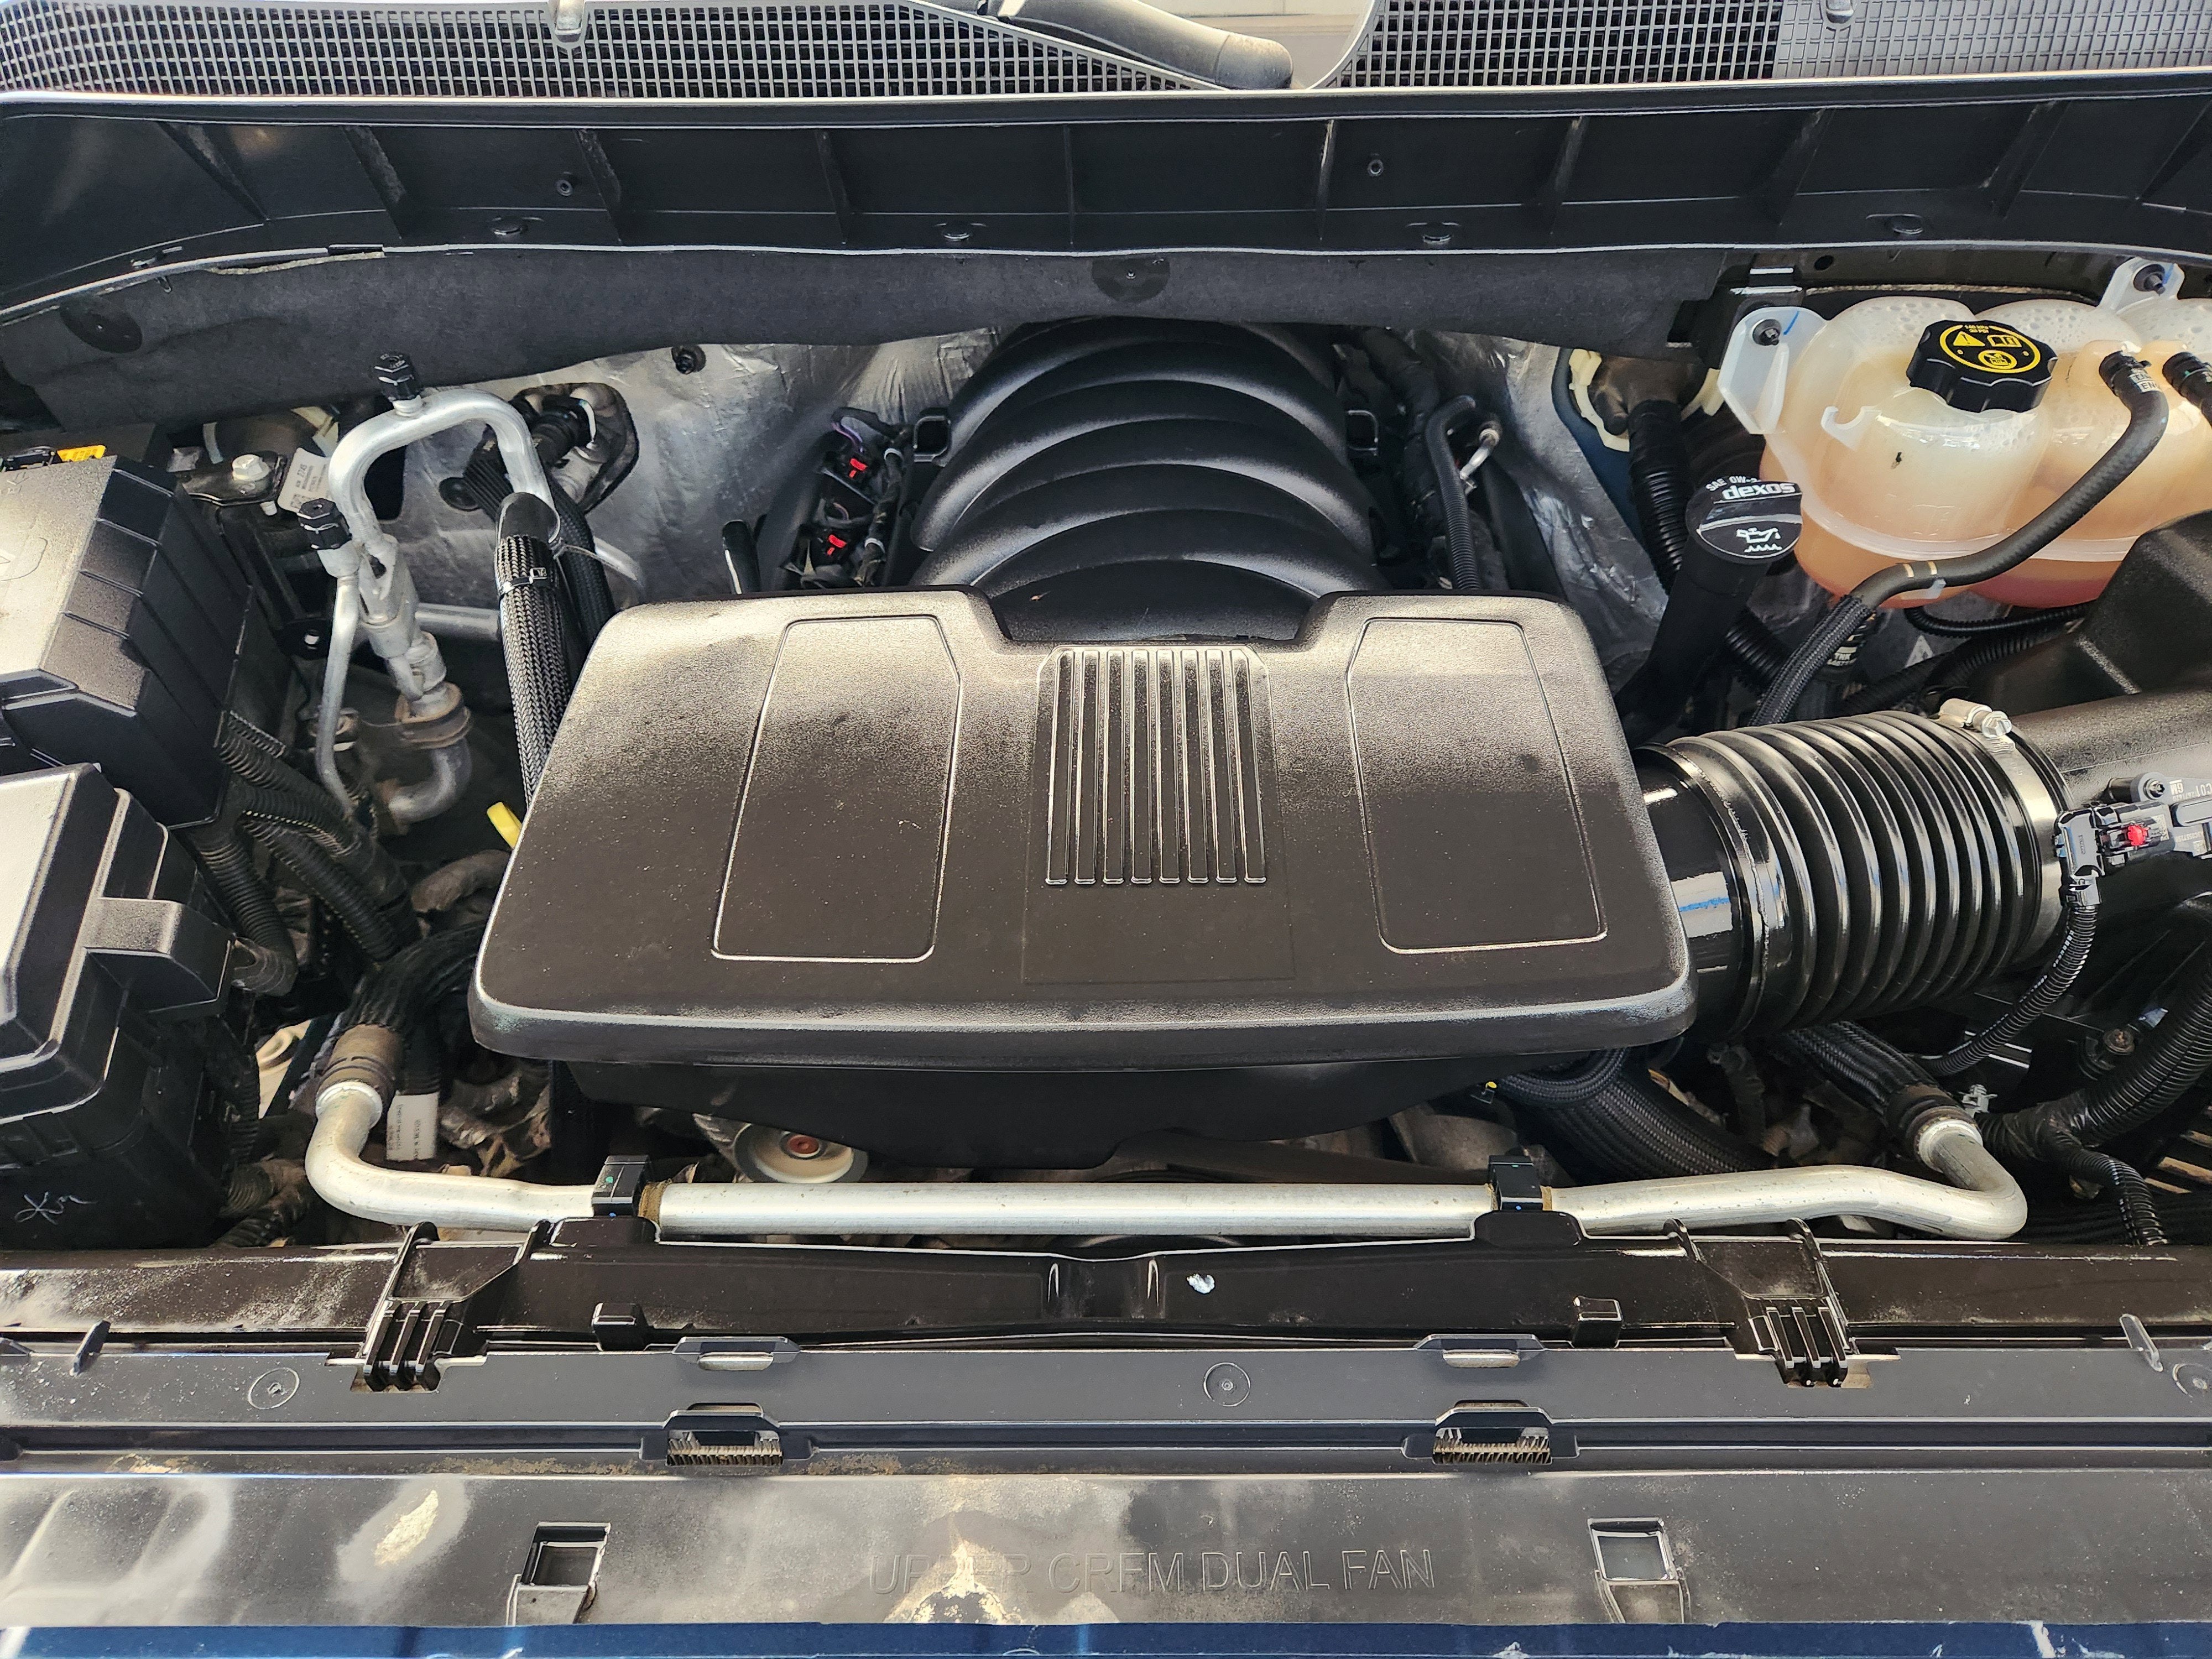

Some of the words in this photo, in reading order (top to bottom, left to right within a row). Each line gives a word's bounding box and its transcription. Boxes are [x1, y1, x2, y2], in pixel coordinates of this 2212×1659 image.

[1705, 478, 1728, 492] SAE
[1721, 483, 1796, 500] dexos
[2170, 782, 2184, 795] GM
[1202, 1549, 1331, 1592] DUAL
[1342, 1548, 1436, 1591] FAN
